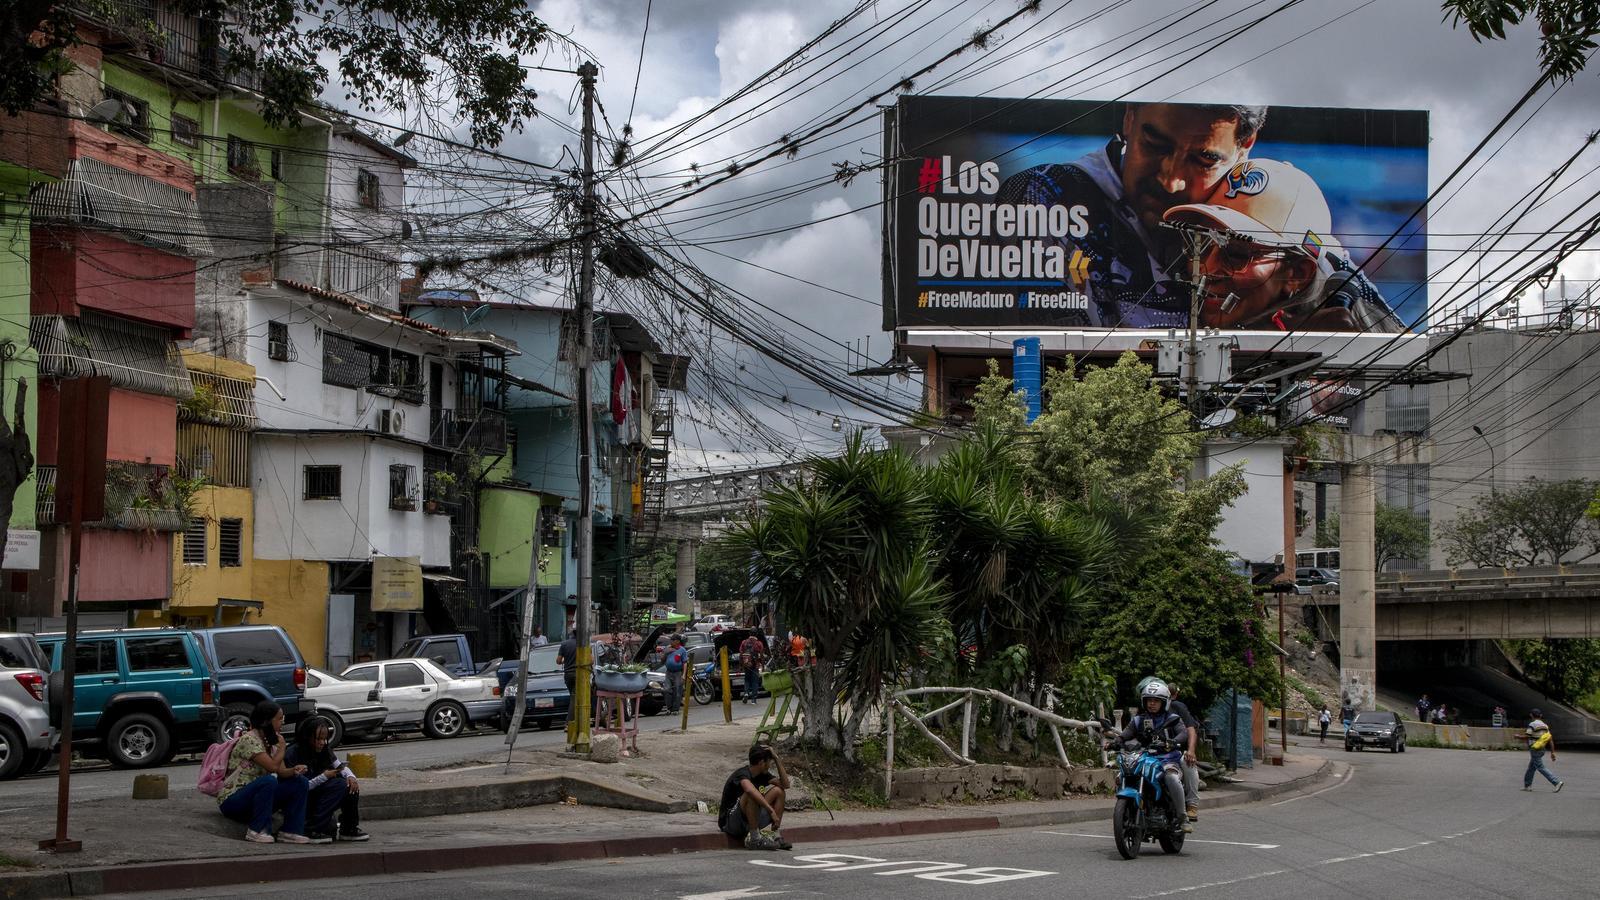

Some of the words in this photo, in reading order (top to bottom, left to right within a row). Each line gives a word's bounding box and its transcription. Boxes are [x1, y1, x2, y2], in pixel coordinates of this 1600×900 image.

[918, 155, 1000, 195] #Los
[918, 197, 1089, 239] Queremos
[918, 238, 1065, 279] DeVuelta
[918, 290, 1014, 308] #FreeMaduro
[1018, 291, 1089, 309] #FreeCilia
[1346, 382, 1362, 396] Óscar
[1335, 415, 1349, 425] estar
